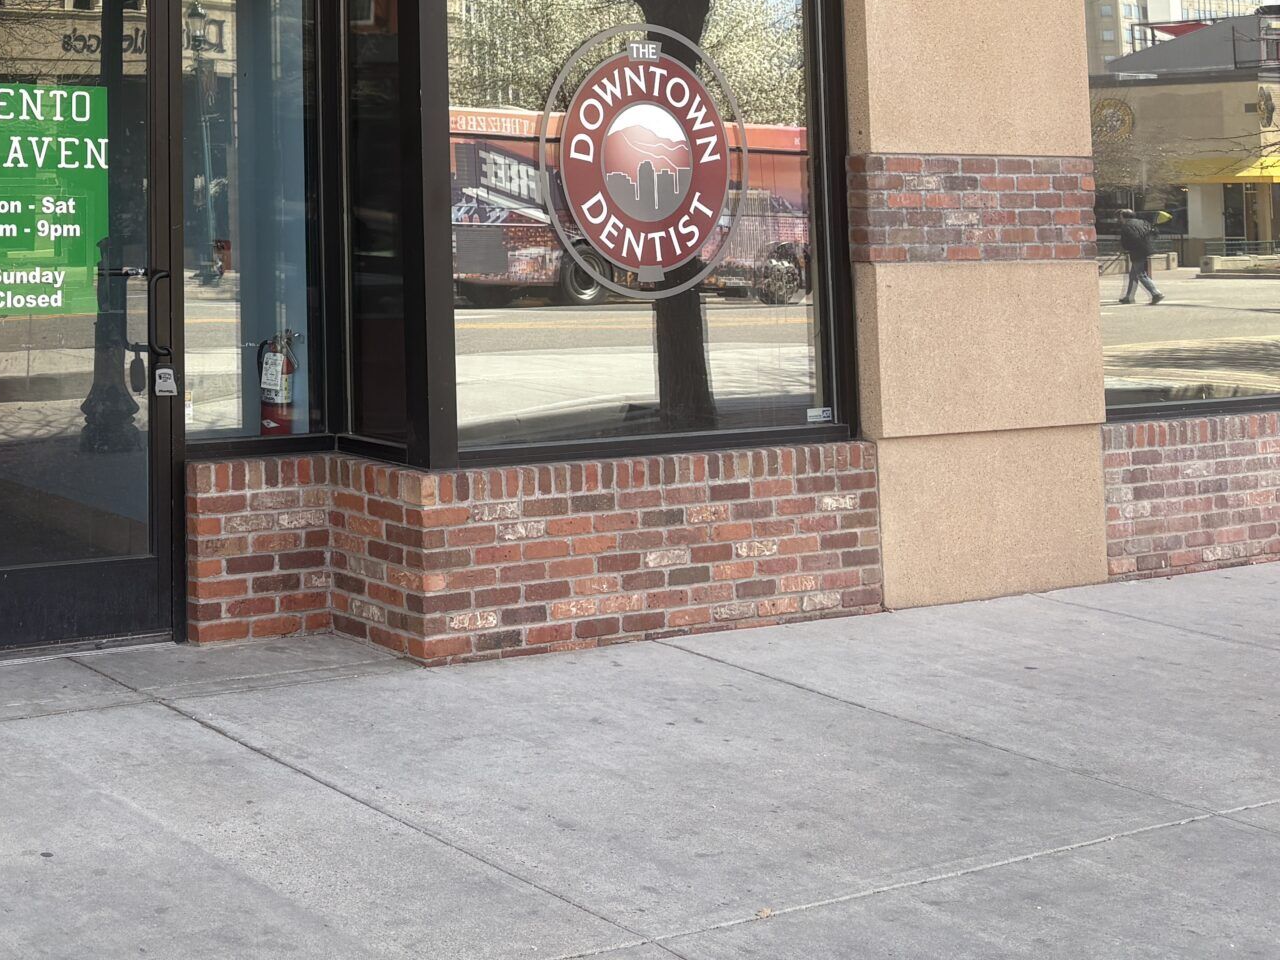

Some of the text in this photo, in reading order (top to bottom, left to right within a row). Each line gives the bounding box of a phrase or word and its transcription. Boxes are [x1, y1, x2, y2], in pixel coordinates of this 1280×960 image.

[630, 43, 657, 59] THE
[570, 65, 721, 164] DOWNTOWN
[42, 197, 75, 214] Sat
[37, 220, 81, 240] 9pm
[580, 191, 714, 262] DENTIST
